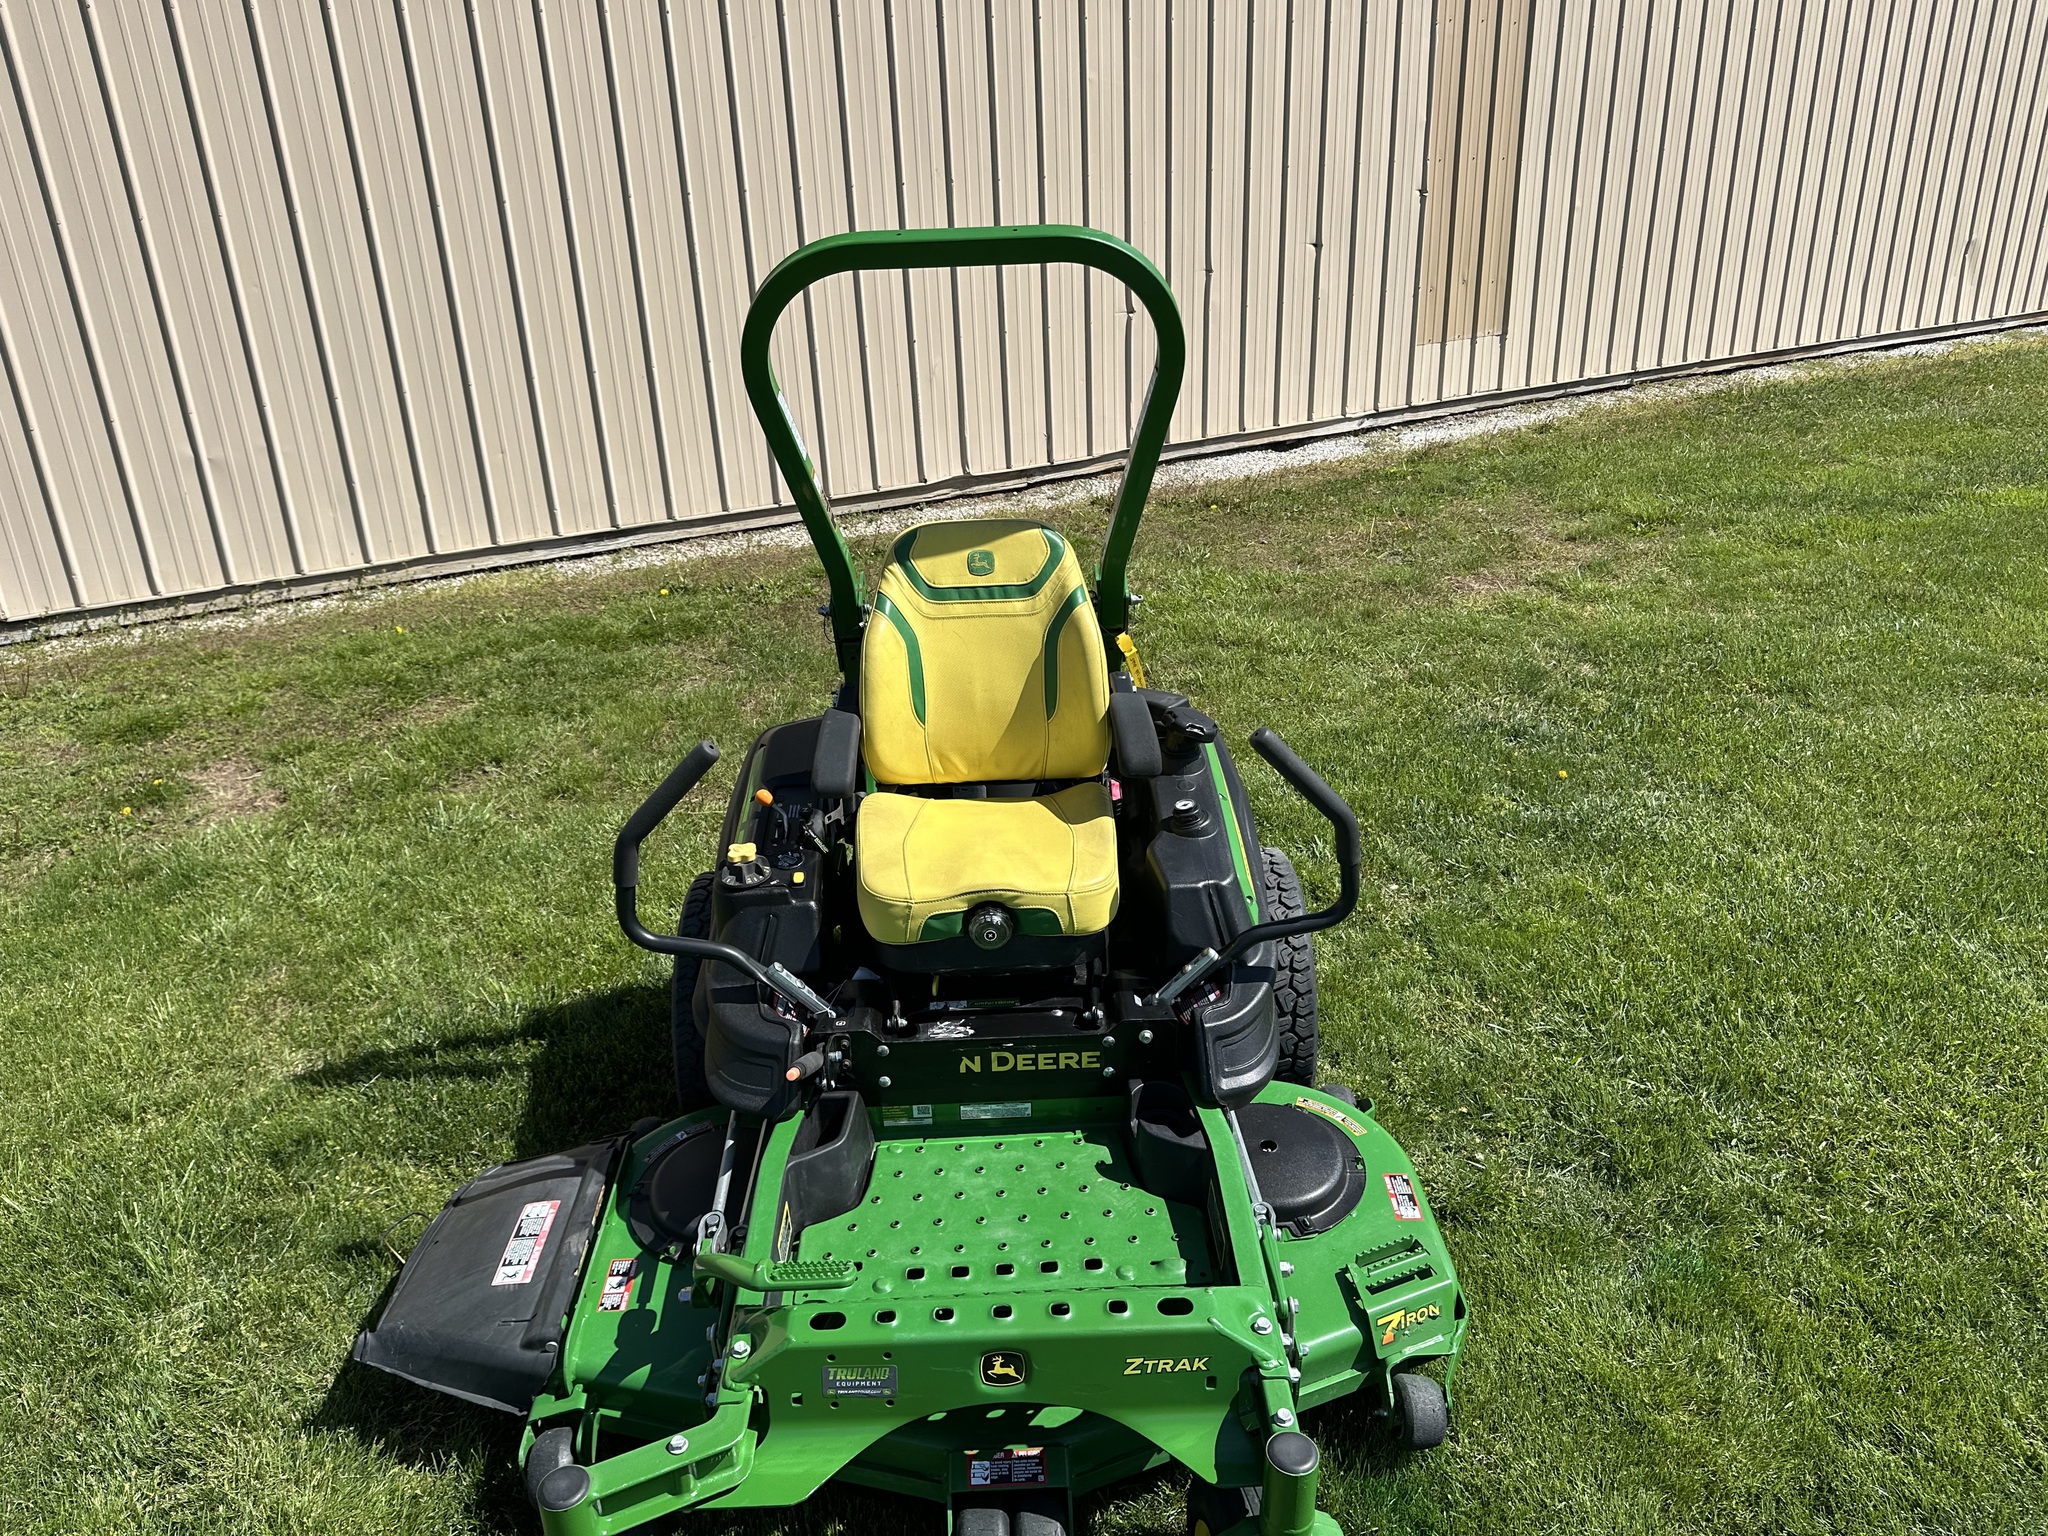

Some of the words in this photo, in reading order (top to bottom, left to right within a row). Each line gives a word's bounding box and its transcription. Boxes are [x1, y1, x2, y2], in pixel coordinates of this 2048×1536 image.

[991, 1051, 1101, 1072] DEERE
[828, 1367, 890, 1380] TRULAND
[1123, 1357, 1209, 1375] ZTRAK
